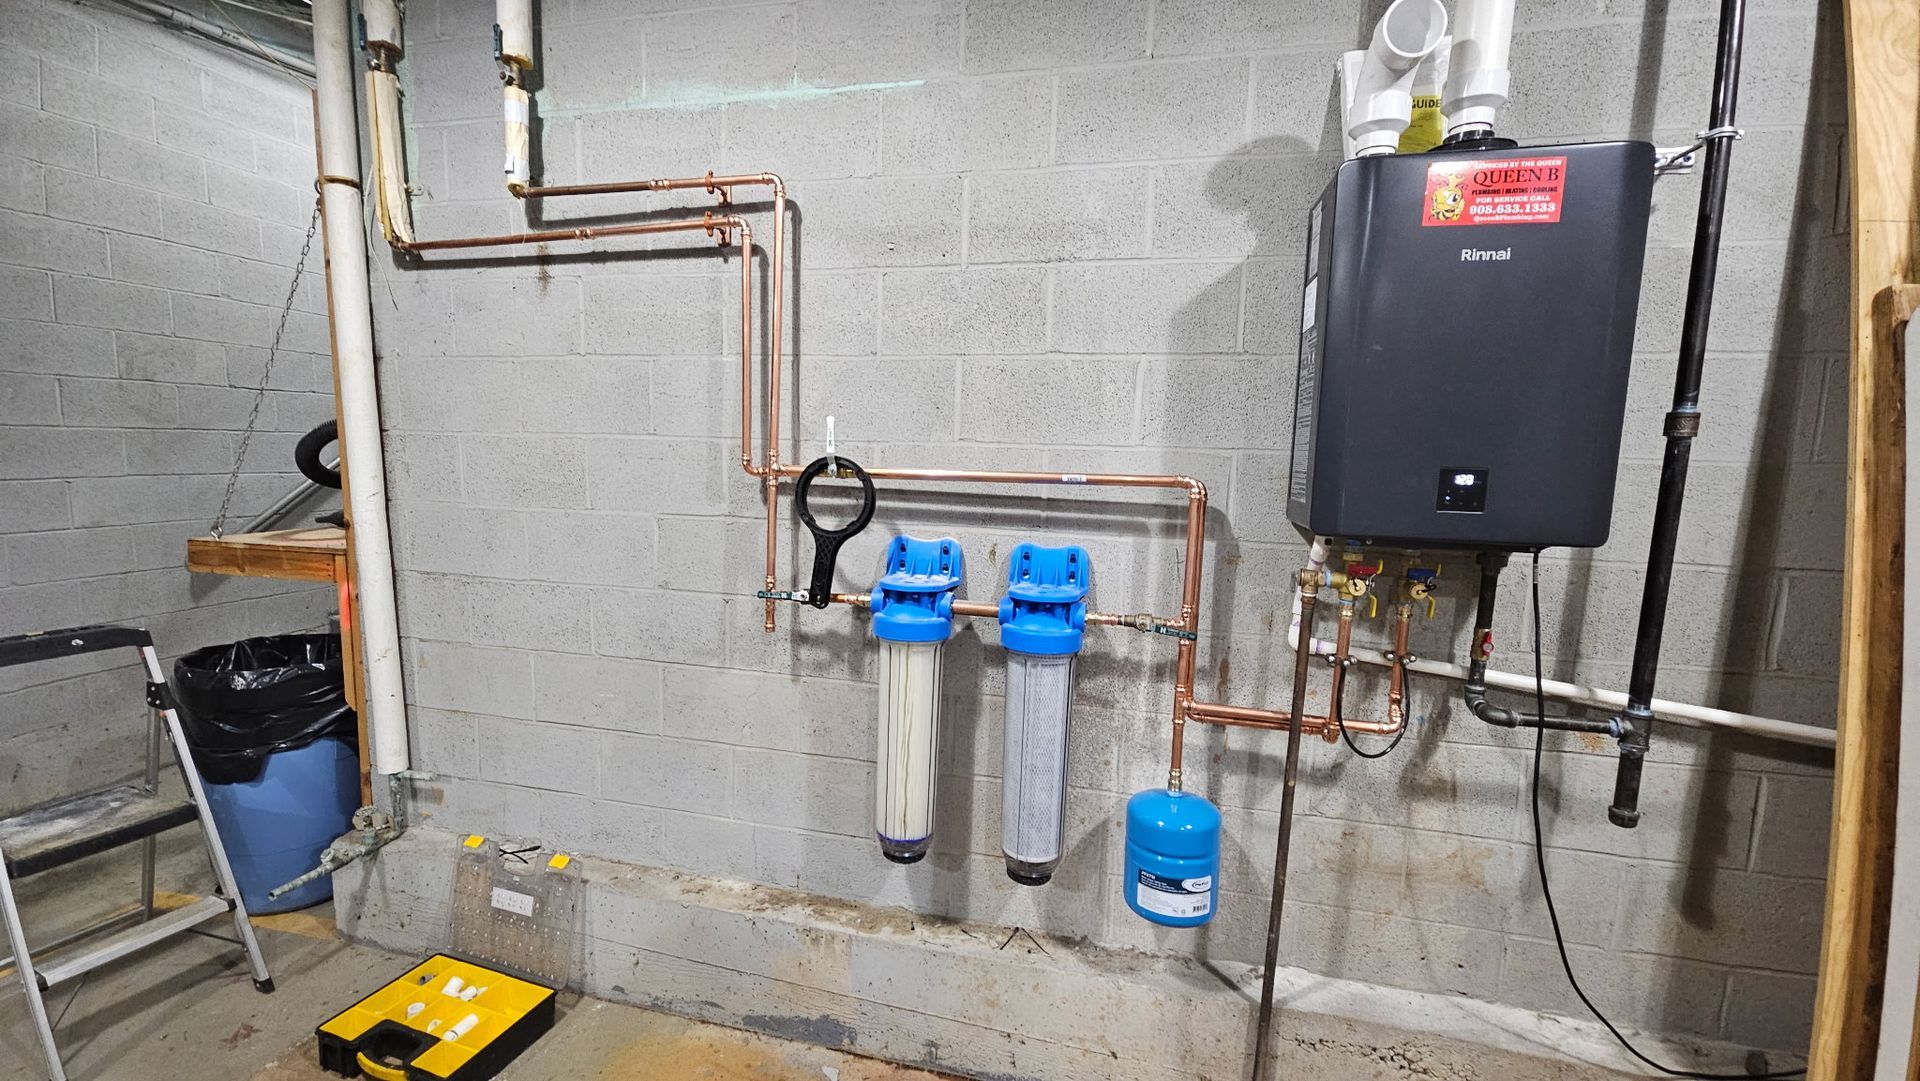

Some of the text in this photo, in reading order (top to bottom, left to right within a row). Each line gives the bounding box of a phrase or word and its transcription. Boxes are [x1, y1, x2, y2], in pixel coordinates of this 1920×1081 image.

[1536, 159, 1562, 167] QUEEN
[1473, 168, 1559, 188] QUEEN B
[1469, 203, 1556, 215] 908.633.1333
[1461, 247, 1511, 262] Rinnai
